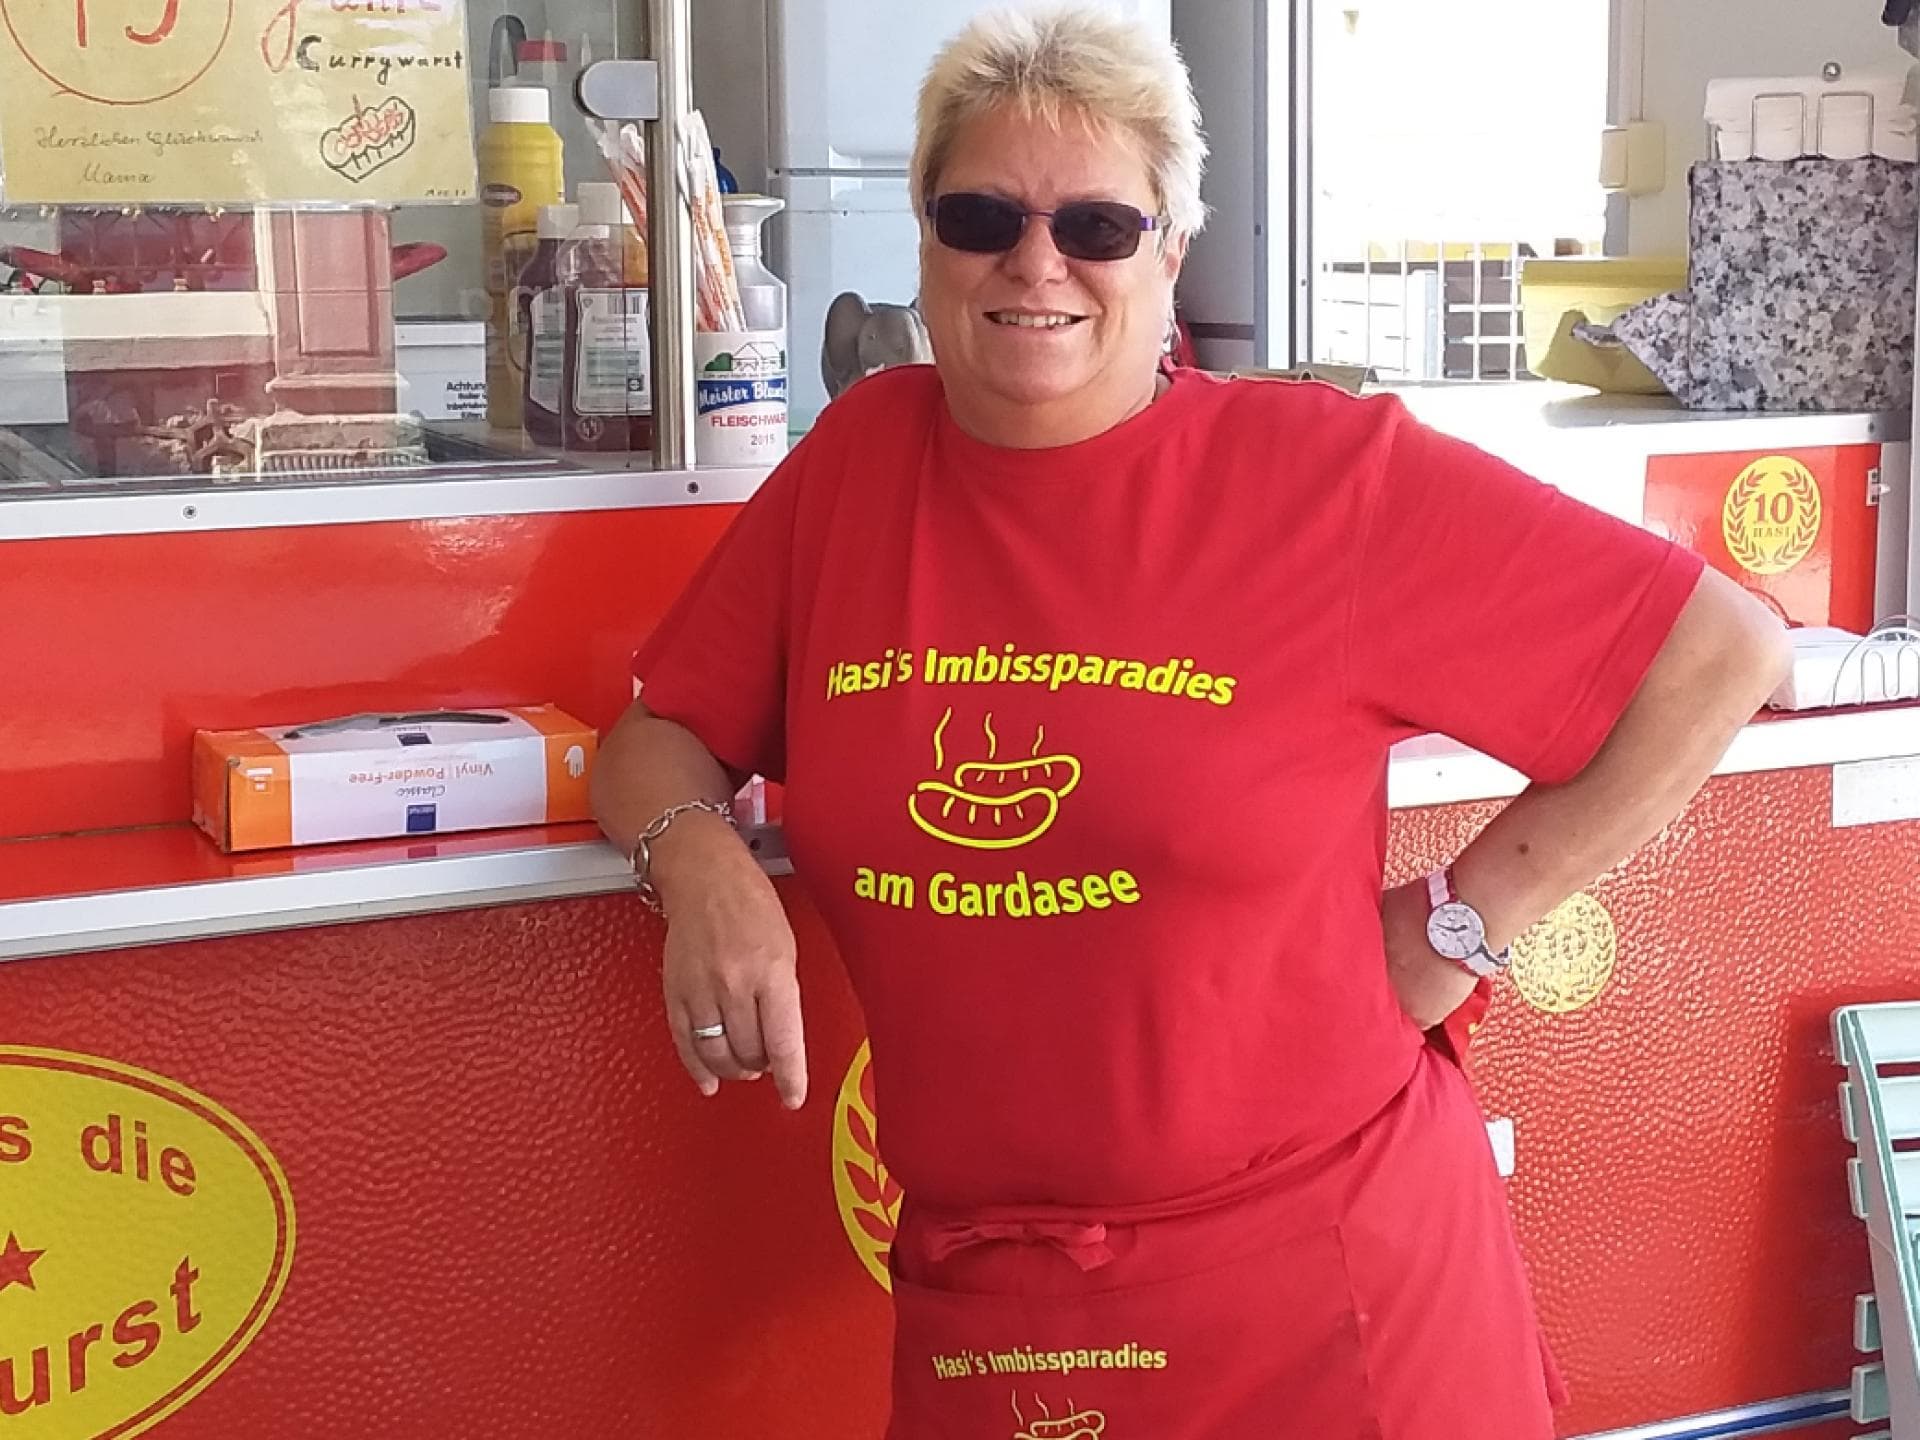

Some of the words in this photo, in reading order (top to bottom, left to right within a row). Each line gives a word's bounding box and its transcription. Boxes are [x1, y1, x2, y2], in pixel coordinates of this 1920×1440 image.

[1754, 492, 1794, 525] 10
[826, 648, 913, 701] Hasi's
[924, 643, 1237, 706] Imbissparadies
[348, 766, 445, 785] Powder-Free
[456, 762, 493, 779] Vinyl
[396, 784, 446, 798] Classic
[854, 866, 915, 908] am
[928, 868, 1141, 918] Gardasee
[80, 1114, 197, 1196] die
[931, 1350, 988, 1380] Hasi's
[988, 1342, 1168, 1376] Imbissparadies
